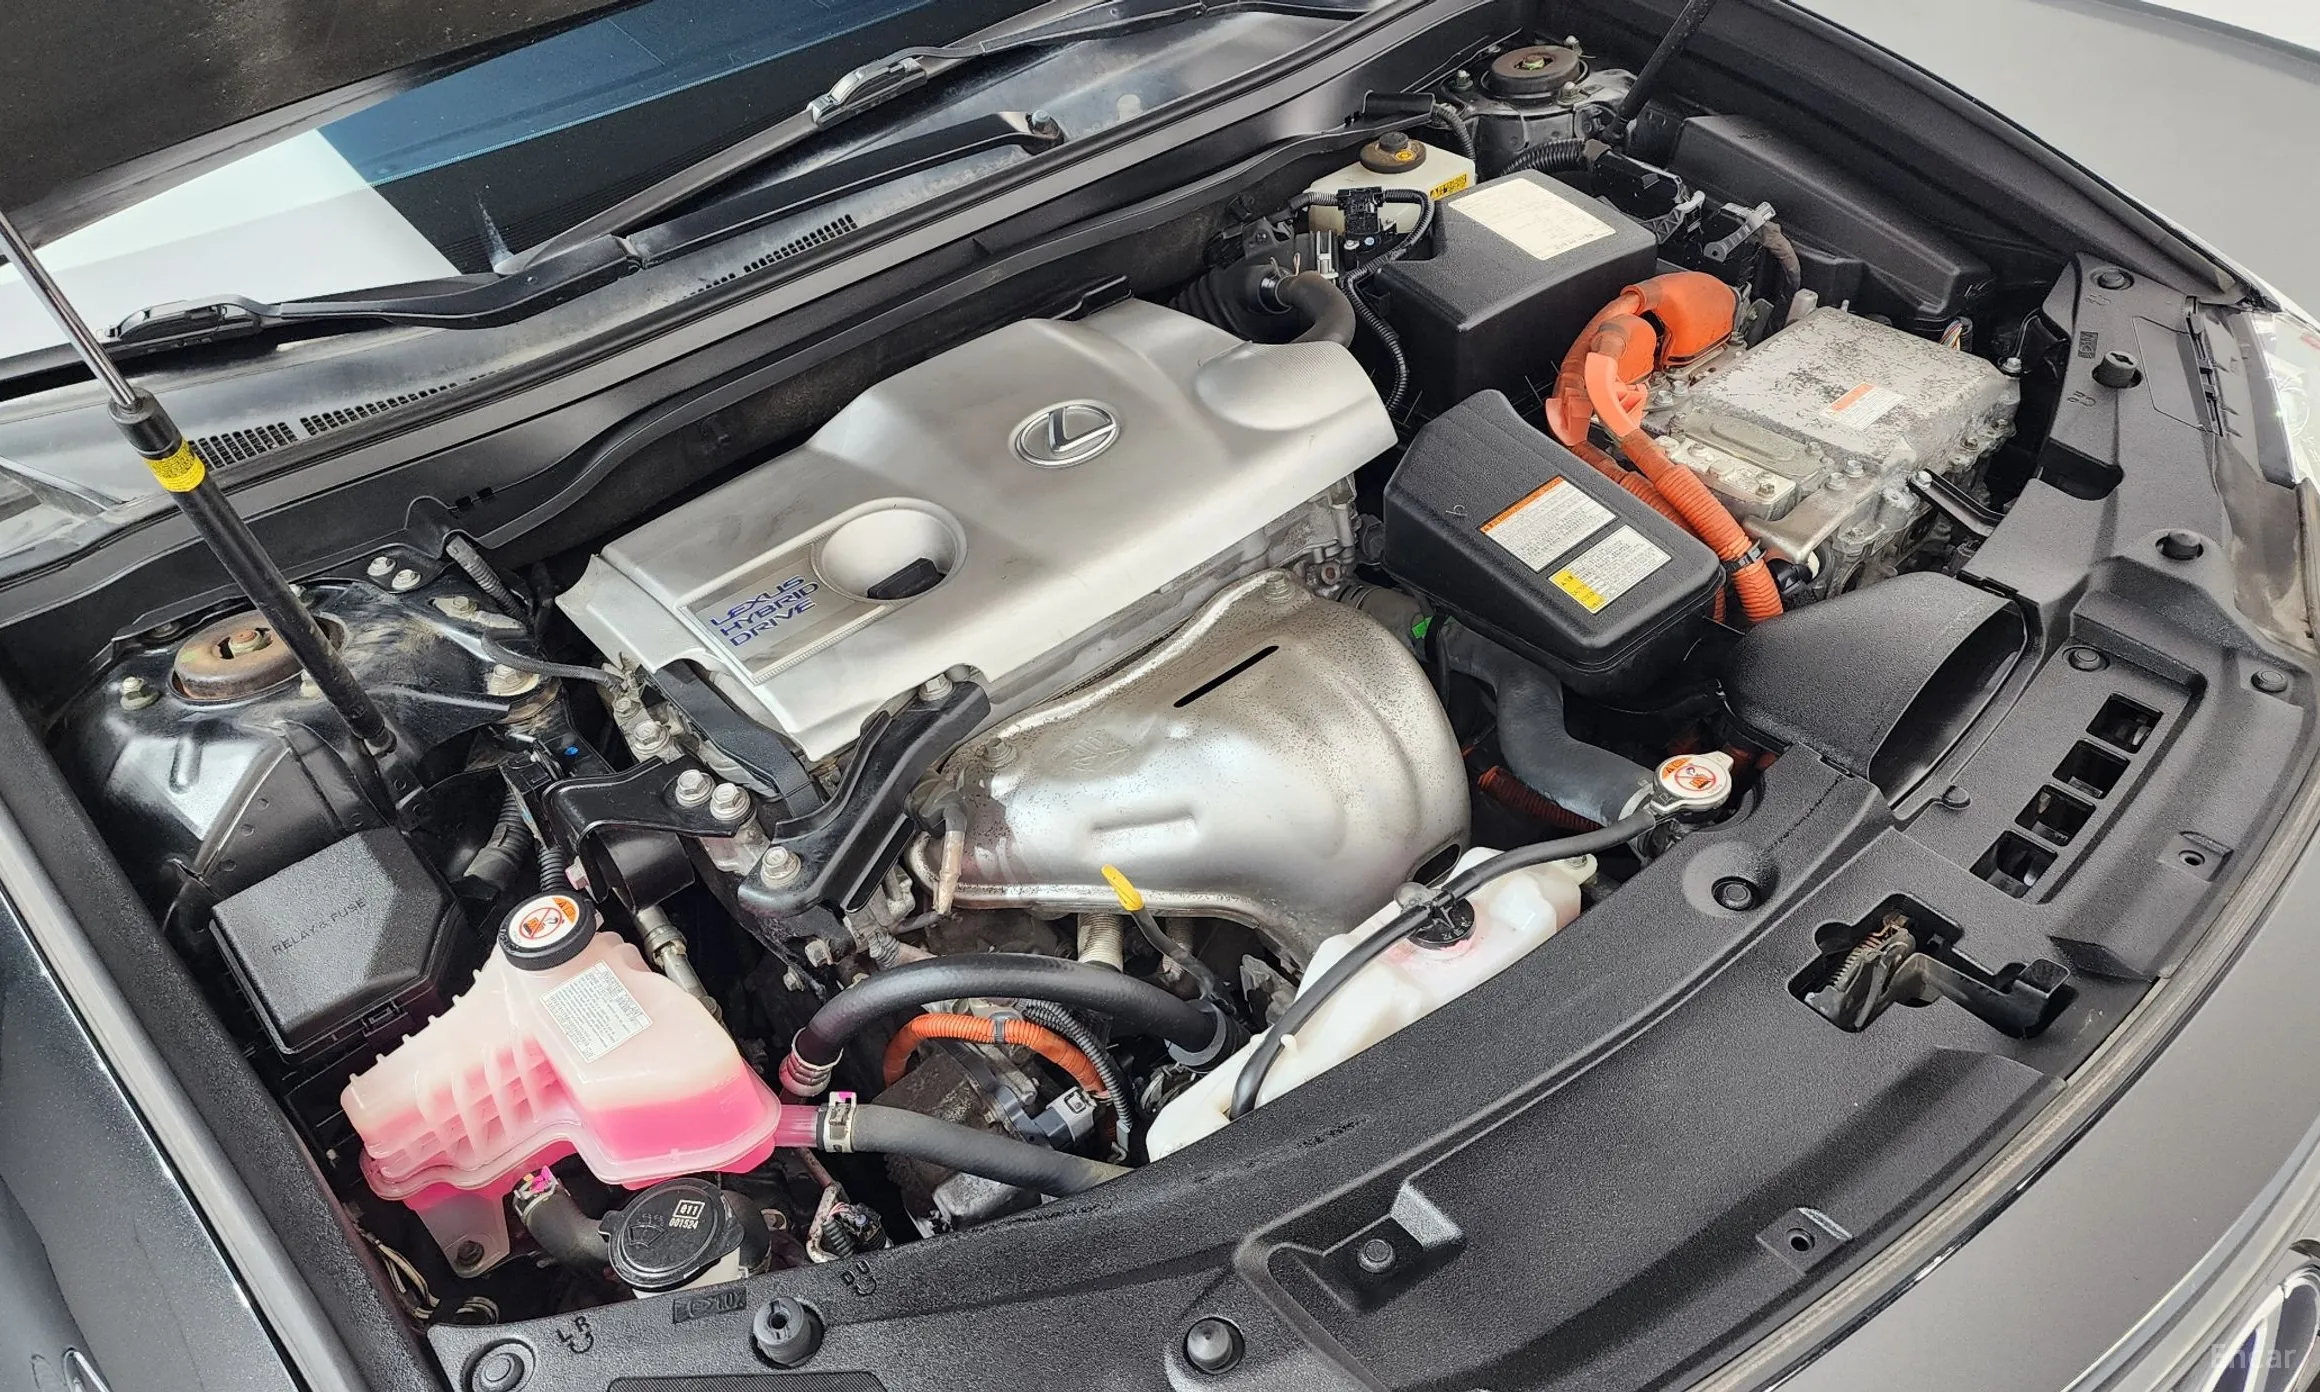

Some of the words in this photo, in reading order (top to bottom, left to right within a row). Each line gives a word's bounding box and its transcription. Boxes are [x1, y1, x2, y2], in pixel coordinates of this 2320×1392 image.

[710, 575, 806, 627] LEXUS
[719, 582, 820, 637] HYBRID
[728, 598, 816, 648] DRIVE
[271, 924, 317, 956] RELAY
[329, 898, 367, 922] FUSE
[668, 1217, 699, 1230] 001524
